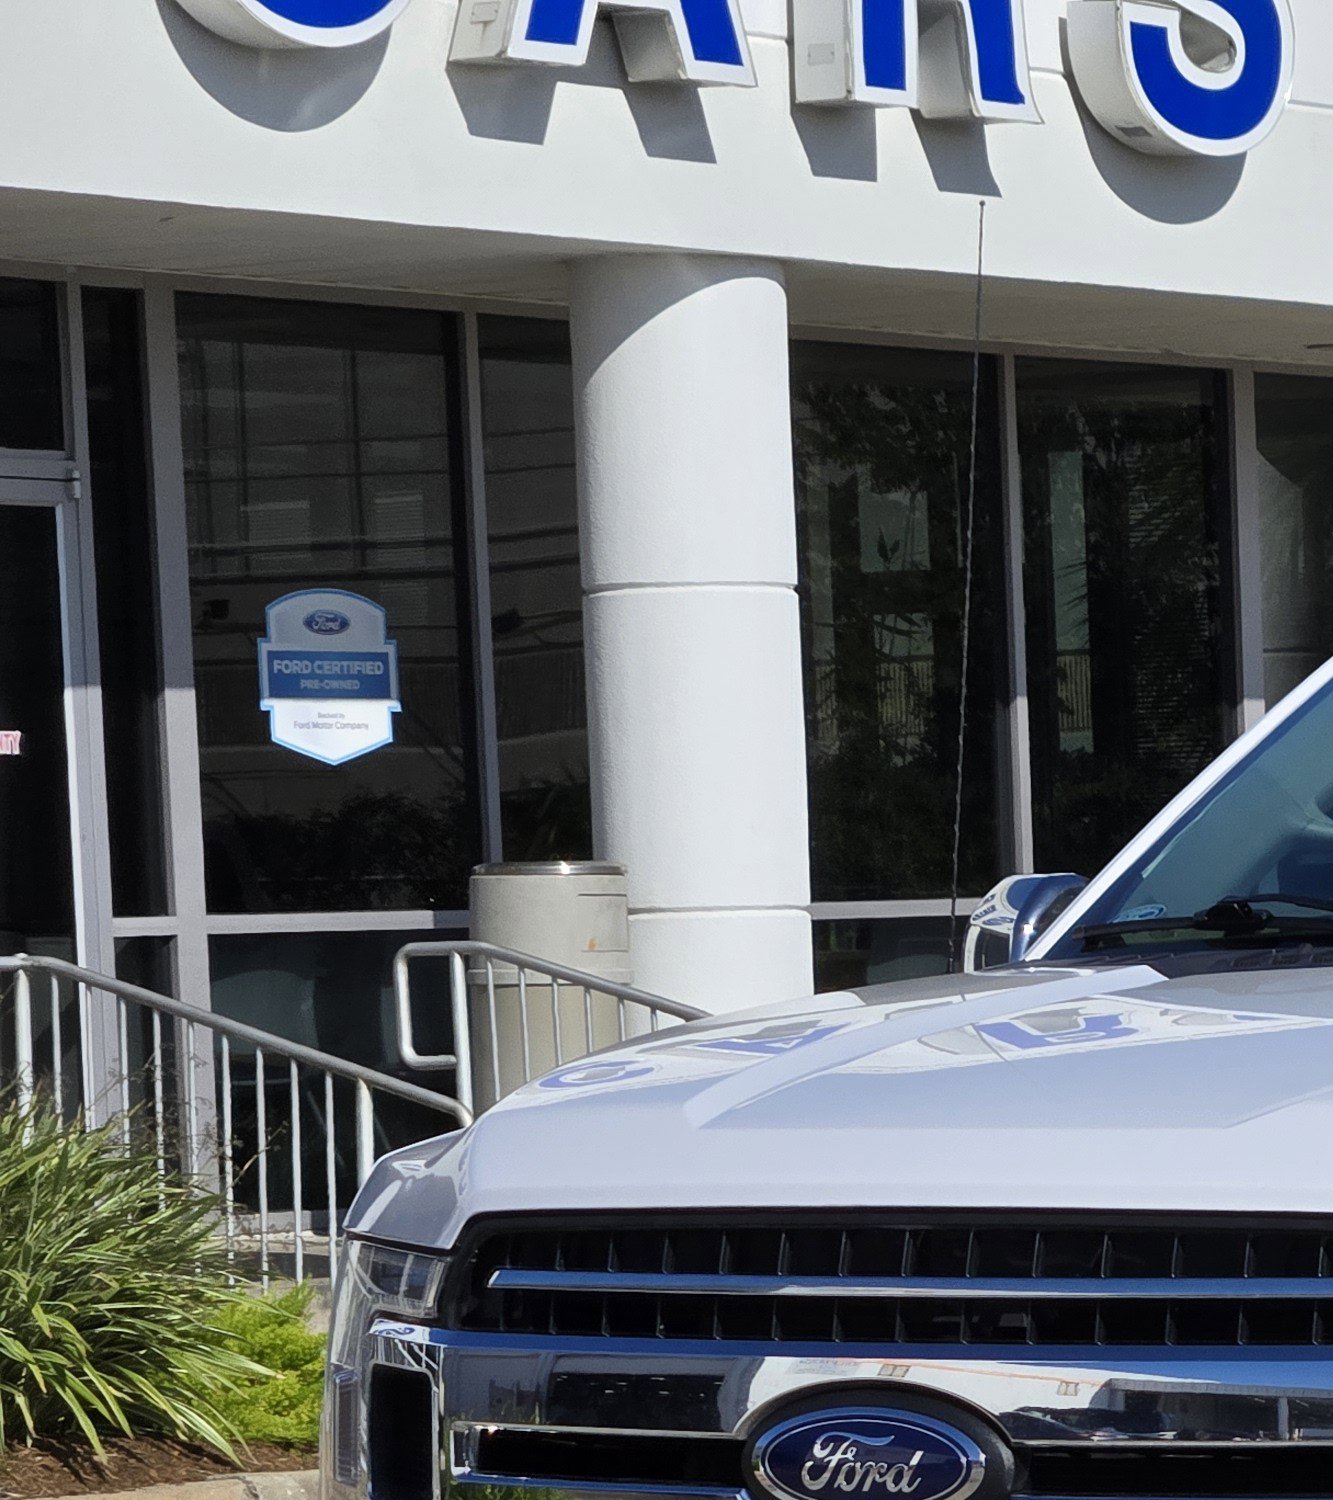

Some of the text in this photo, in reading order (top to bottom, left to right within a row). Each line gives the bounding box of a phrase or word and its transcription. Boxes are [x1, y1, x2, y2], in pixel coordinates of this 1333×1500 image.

[312, 614, 341, 631] Ford
[273, 659, 385, 676] FORD CERTIFIED
[300, 679, 361, 690] PRE-OWNED
[801, 1431, 922, 1493] Ford
